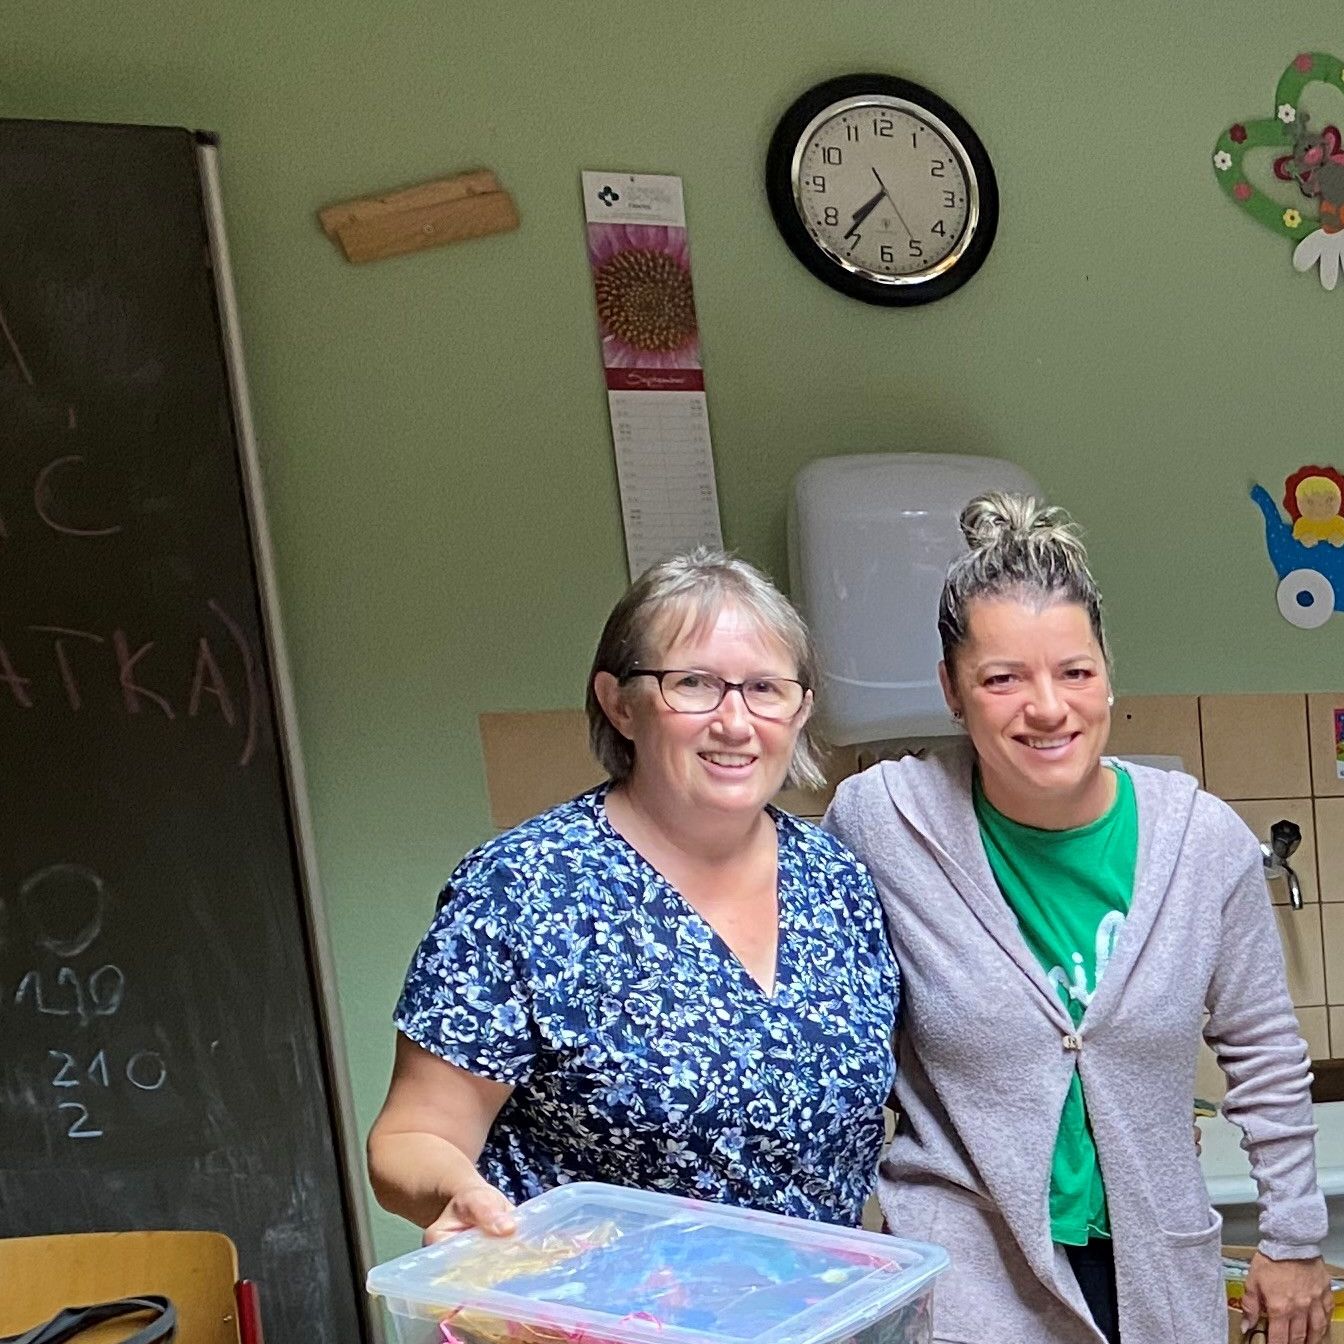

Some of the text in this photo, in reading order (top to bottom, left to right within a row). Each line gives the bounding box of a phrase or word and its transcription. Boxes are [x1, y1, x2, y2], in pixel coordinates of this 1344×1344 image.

[846, 124, 860, 142] 11
[873, 118, 894, 138] 12
[911, 132, 918, 149] 1
[821, 146, 843, 166] 10
[930, 159, 945, 178] 2
[812, 175, 826, 193] 9
[942, 189, 956, 208] 3
[824, 206, 839, 226] 8
[930, 219, 946, 238] 4
[879, 245, 894, 263] 6
[908, 239, 924, 258] 5
[49, 1049, 167, 1091] 210
[58, 1101, 104, 1139] 2
